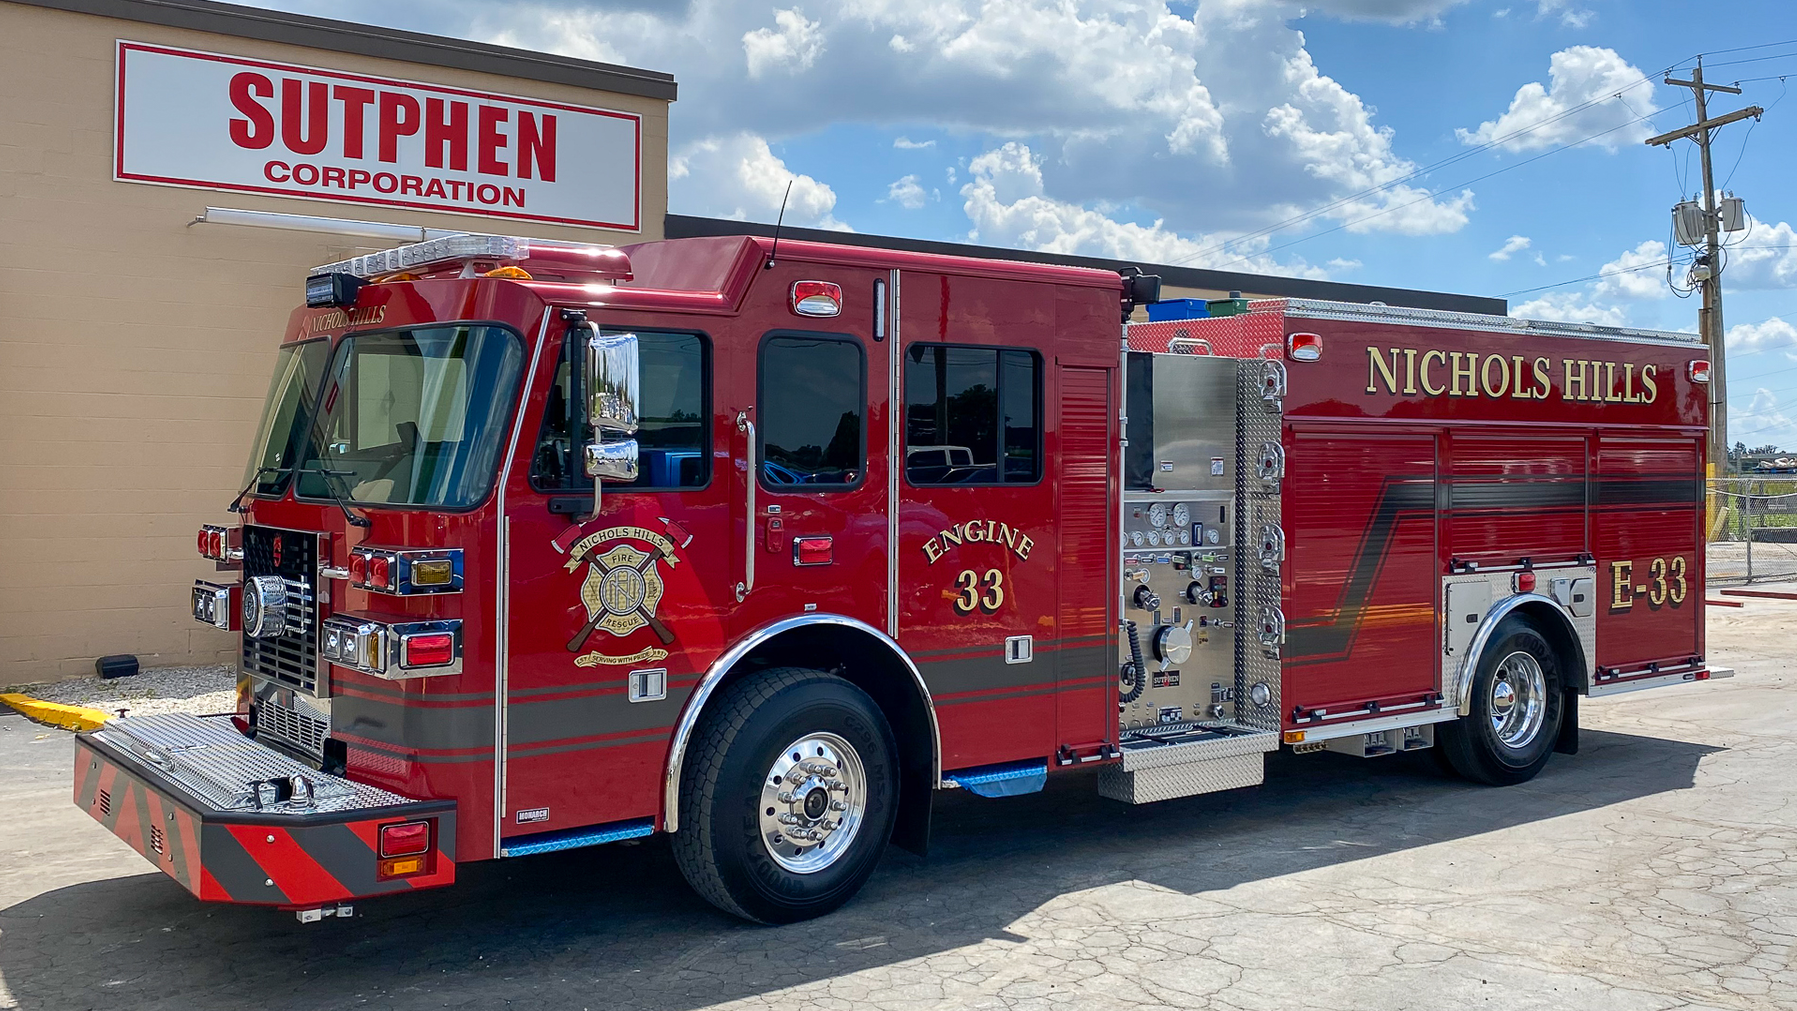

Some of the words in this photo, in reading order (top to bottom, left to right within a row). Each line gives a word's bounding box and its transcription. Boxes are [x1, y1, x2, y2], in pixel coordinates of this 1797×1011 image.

[228, 71, 558, 183] SUTPHEN
[263, 160, 526, 208] CORPORATION
[310, 310, 350, 333] NICHOLS
[350, 304, 387, 326] HILLS
[1366, 346, 1551, 399] NICHOLS
[1562, 359, 1658, 404] HILLS
[579, 527, 629, 552] NICHOLS
[633, 528, 665, 547] HILLS
[921, 519, 1035, 565] ENGINE
[611, 554, 634, 564] FIRE
[955, 568, 1004, 612] 33
[1610, 555, 1688, 609] E-33
[605, 616, 640, 628] RESCUE
[592, 655, 617, 664] SERVING
[633, 651, 651, 661] PRIDE
[519, 809, 548, 820] MONARCH
